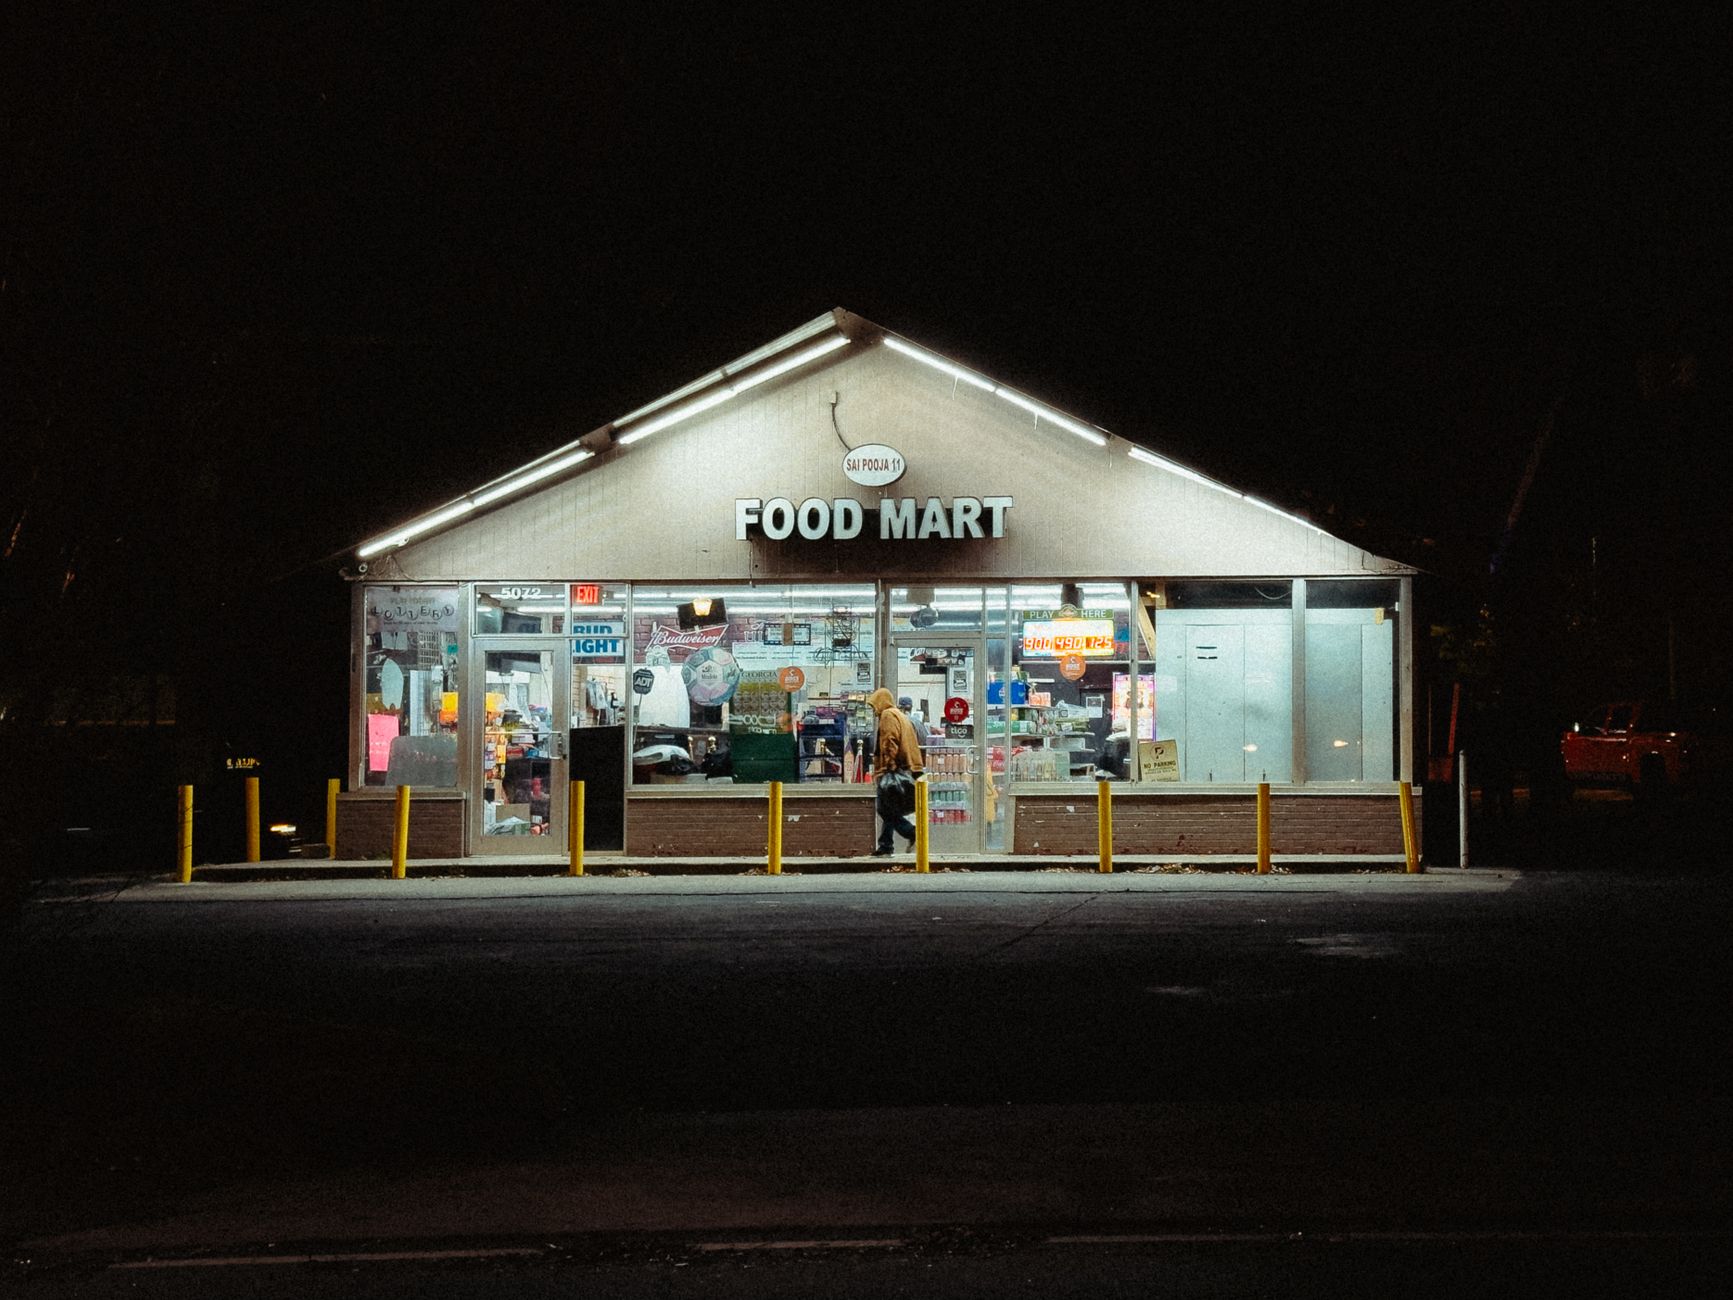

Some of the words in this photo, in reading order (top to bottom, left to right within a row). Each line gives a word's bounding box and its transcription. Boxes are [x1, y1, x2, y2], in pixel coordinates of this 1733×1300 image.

[846, 458, 860, 471] SAI
[862, 458, 889, 471] POOJA
[892, 458, 901, 471] 11
[735, 497, 864, 541] FOOD
[879, 496, 1014, 540] MART
[501, 587, 541, 600] 5072
[576, 586, 599, 603] EXIT
[1030, 610, 1055, 619] PLAY
[1081, 609, 1106, 618] HERE
[573, 624, 613, 634] BUD
[652, 629, 721, 646] Budweiser
[1056, 637, 1082, 650] 490
[1089, 637, 1113, 650] 125
[573, 639, 620, 653] IGHT
[634, 676, 653, 686] ADT
[741, 671, 777, 679] GEORGIA
[1153, 760, 1177, 768] PARKING
